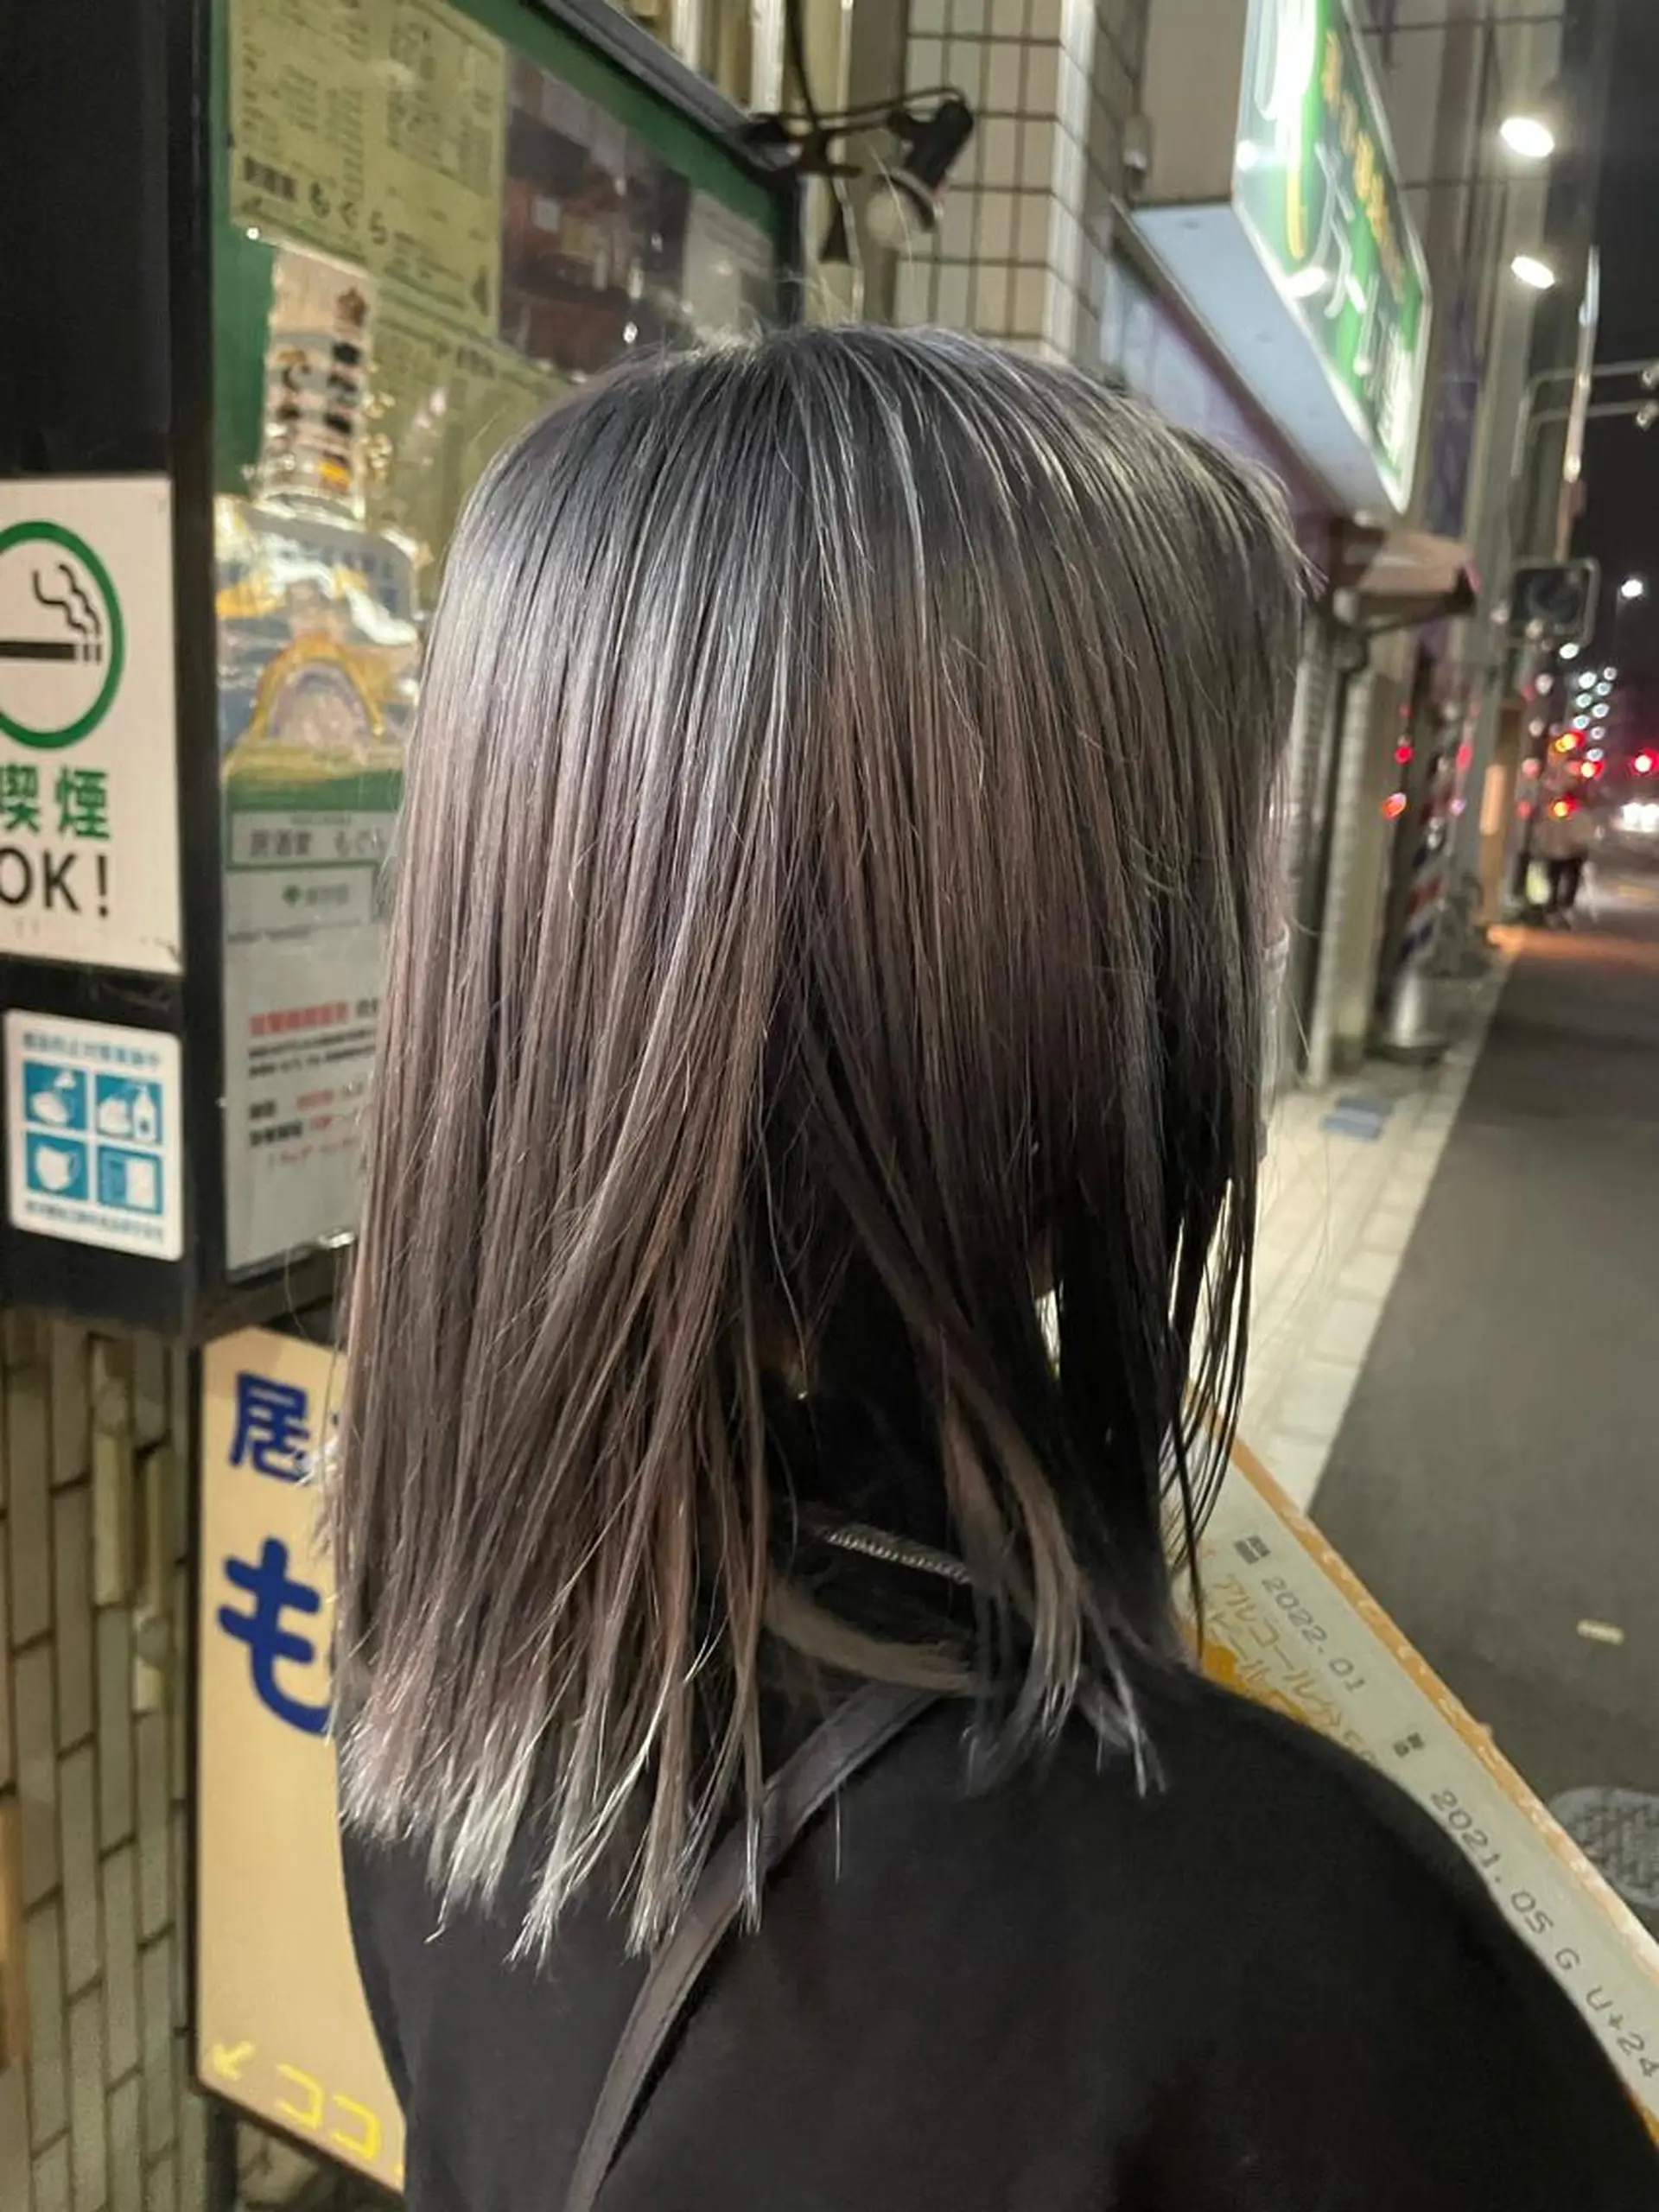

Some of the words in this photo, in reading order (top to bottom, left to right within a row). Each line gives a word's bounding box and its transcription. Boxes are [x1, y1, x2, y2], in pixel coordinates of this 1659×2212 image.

[0, 764, 110, 839] 喫煙
[0, 848, 108, 918] OK!
[218, 1536, 332, 1737] も
[1262, 1575, 1365, 1692] 2022.01
[1555, 1948, 1580, 1972] G
